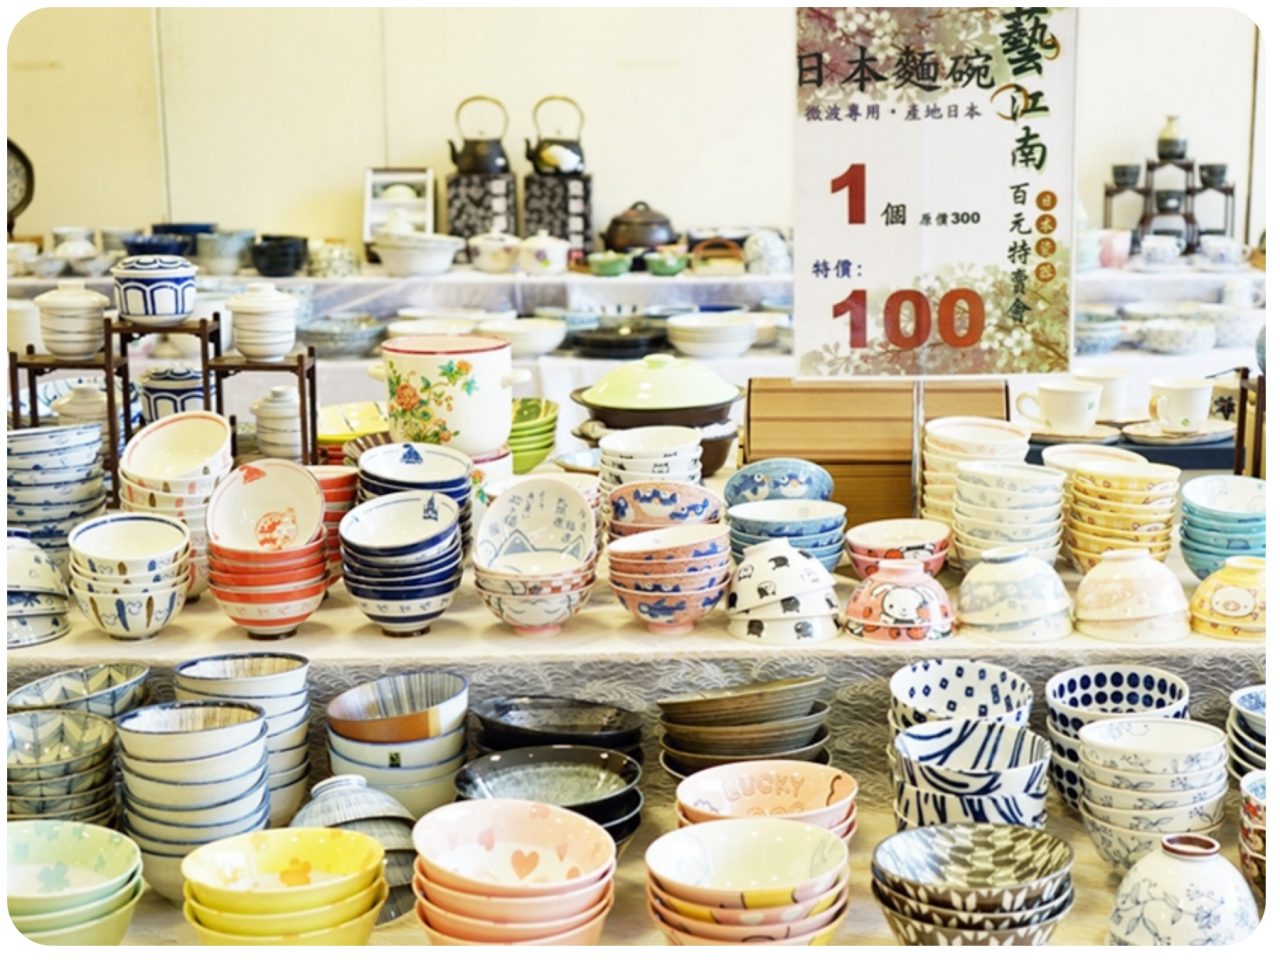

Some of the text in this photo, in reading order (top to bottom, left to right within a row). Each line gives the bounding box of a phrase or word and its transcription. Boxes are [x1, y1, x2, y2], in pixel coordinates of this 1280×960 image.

[798, 45, 995, 92] 日本麵碗
[831, 164, 866, 224] 1
[881, 202, 907, 226] 個
[1007, 182, 1032, 323] 百元特賣會
[832, 289, 986, 349] 100
[721, 773, 805, 802] LUCKY
